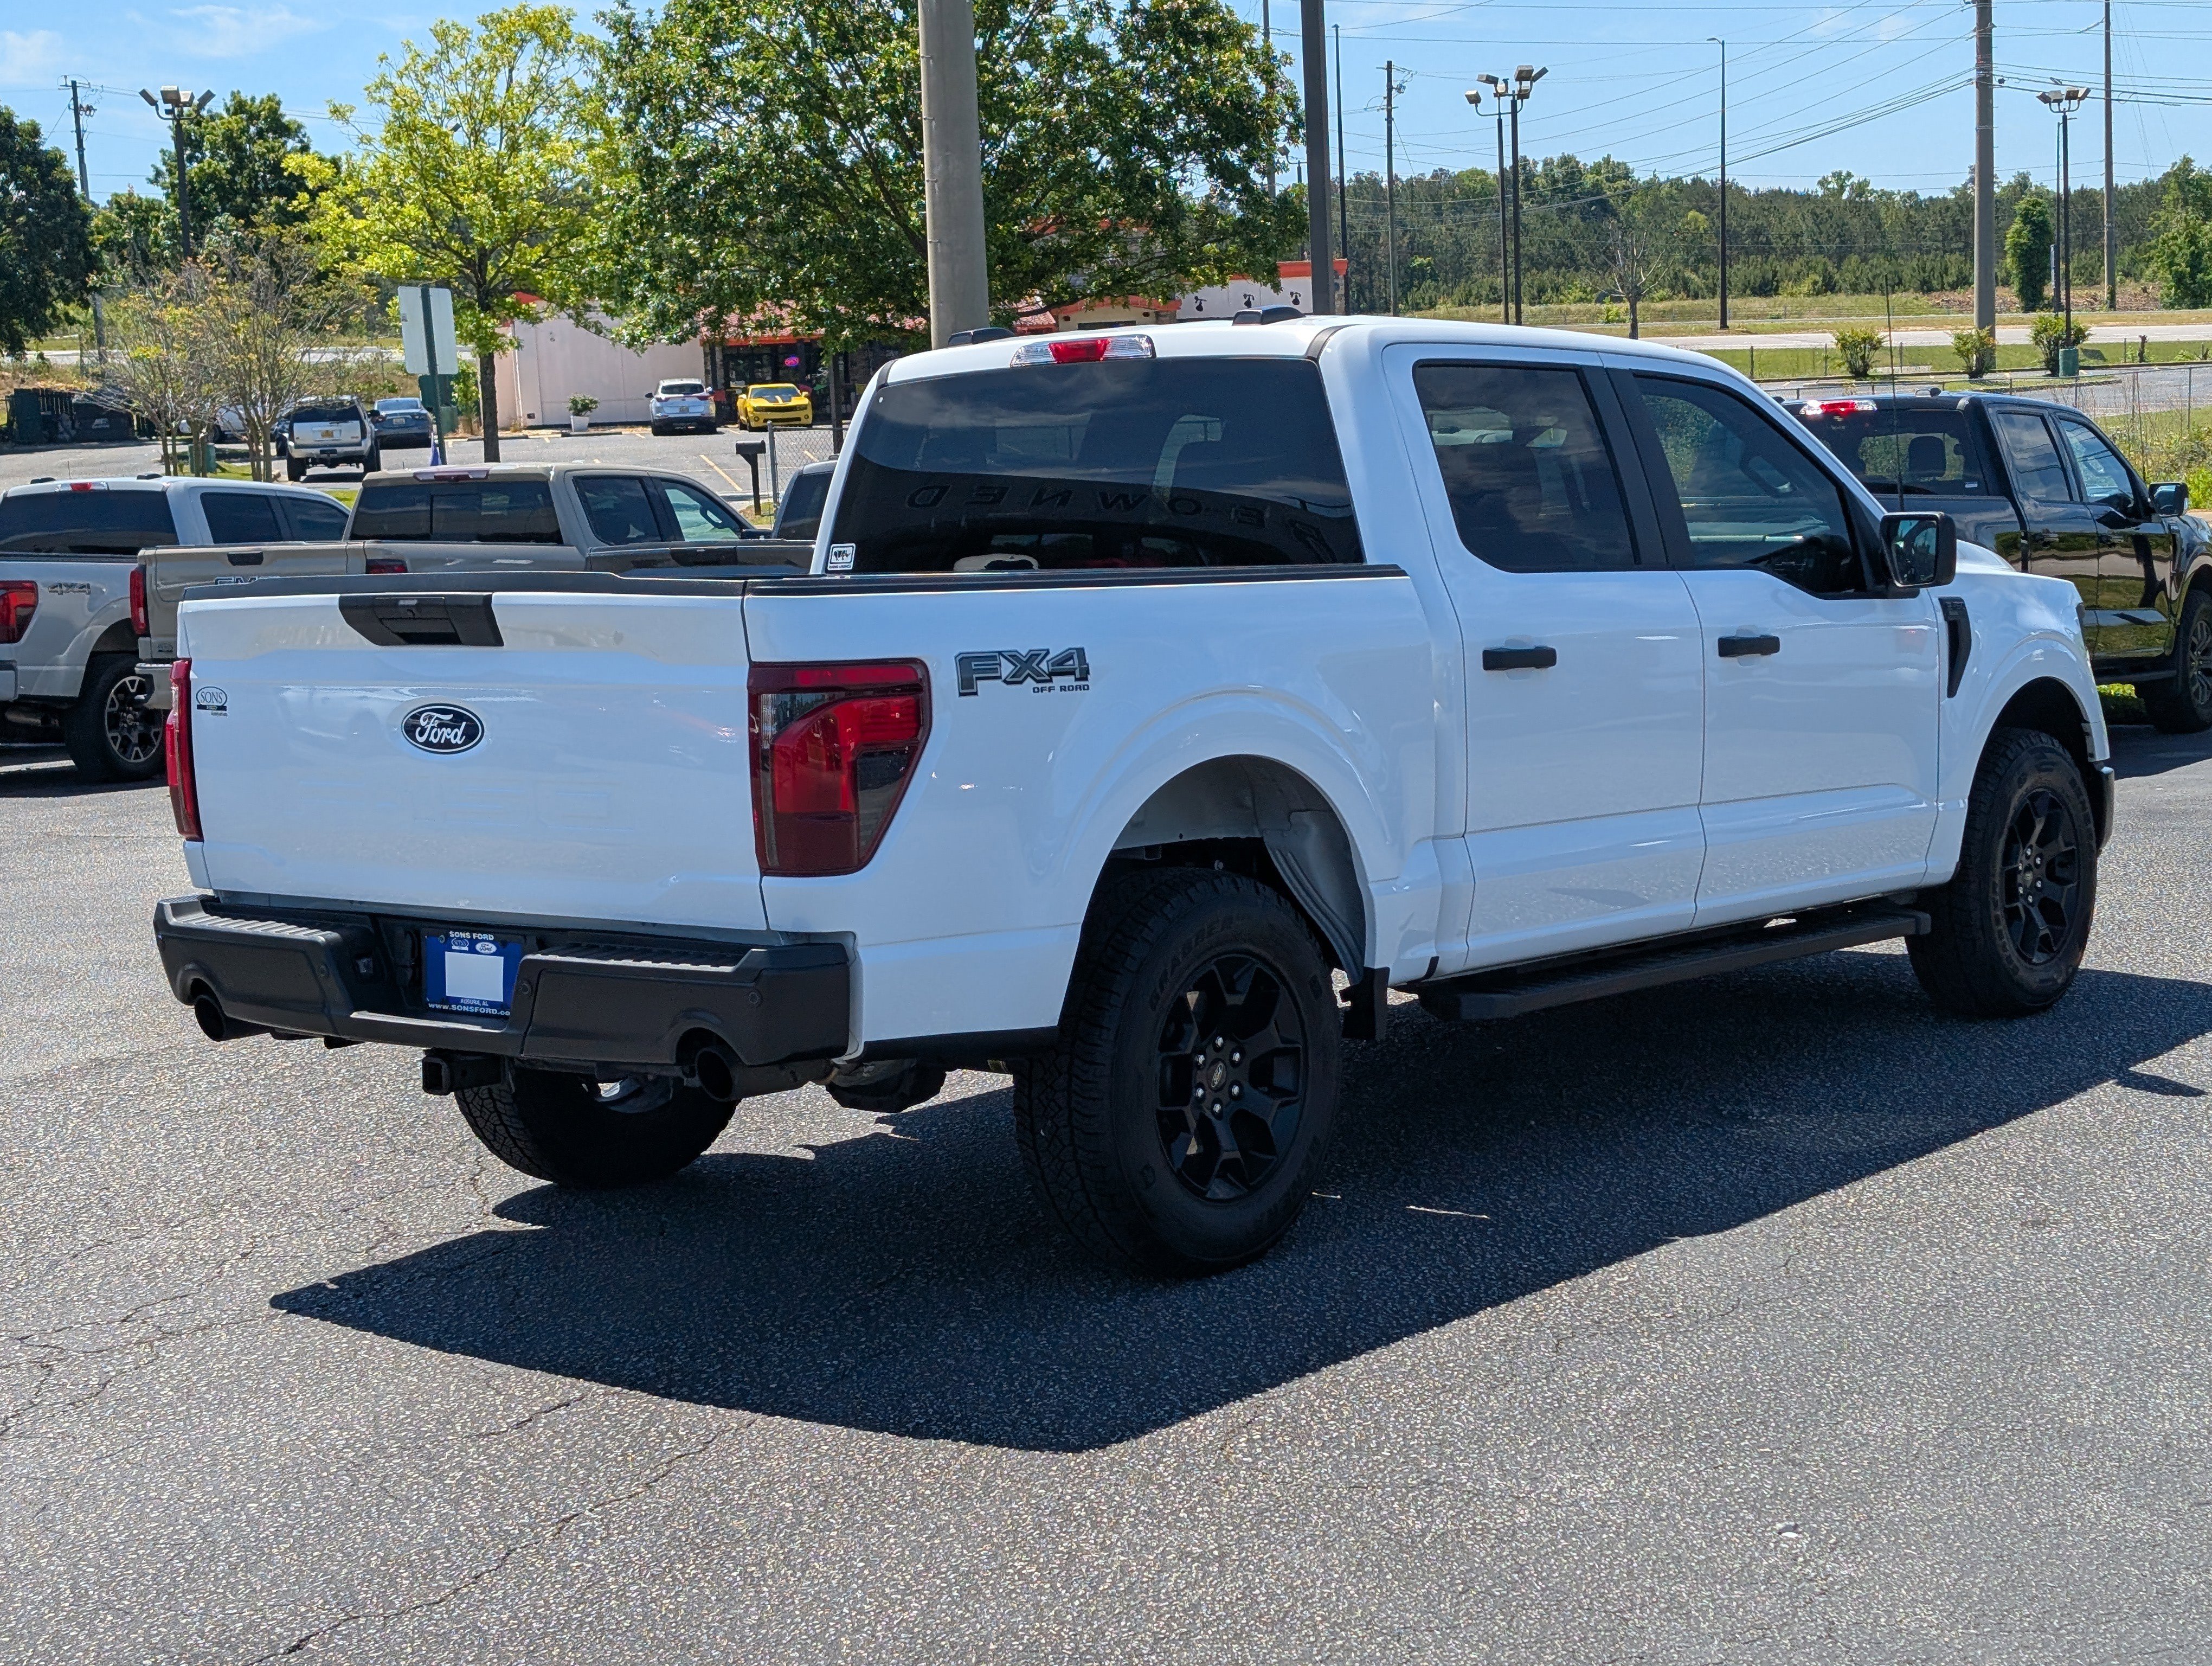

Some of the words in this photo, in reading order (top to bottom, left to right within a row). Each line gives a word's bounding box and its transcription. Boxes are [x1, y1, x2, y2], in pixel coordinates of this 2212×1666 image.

[954, 647, 1090, 697] FX4
[1033, 685, 1056, 694] OFF
[1059, 684, 1090, 693] ROAD
[201, 691, 223, 704] SONS
[415, 712, 466, 744] Ford
[449, 931, 471, 939] SONS
[473, 932, 494, 941] FORD
